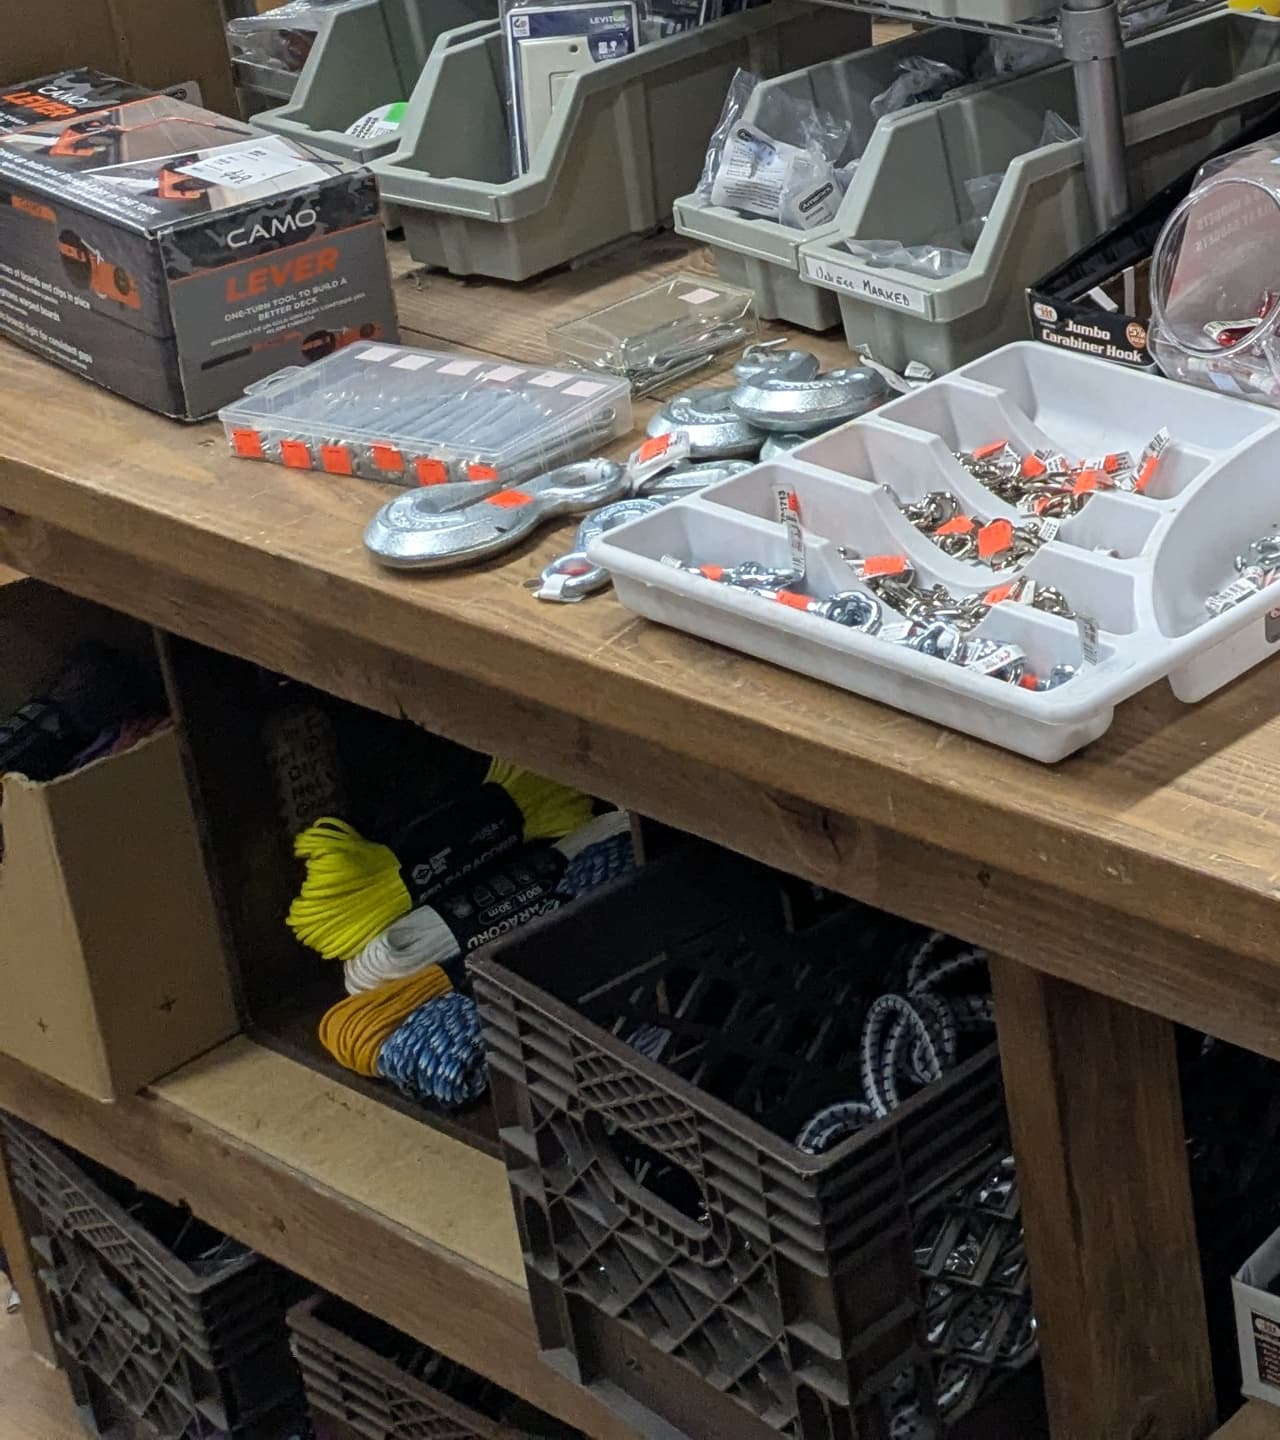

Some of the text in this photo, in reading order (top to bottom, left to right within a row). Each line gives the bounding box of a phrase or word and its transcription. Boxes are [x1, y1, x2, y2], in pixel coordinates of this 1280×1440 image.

[1, 92, 77, 118] LEVER
[38, 86, 89, 106] CAMO
[226, 209, 318, 249] CAMO
[224, 247, 339, 303] LEVER
[224, 282, 335, 322] ONE-TURN TOOL TO BUILD
[863, 280, 910, 306] MARKED
[258, 296, 318, 321] BETTER DECK
[1065, 320, 1111, 340] Jumbo
[1042, 329, 1142, 362] Carabiner Hook
